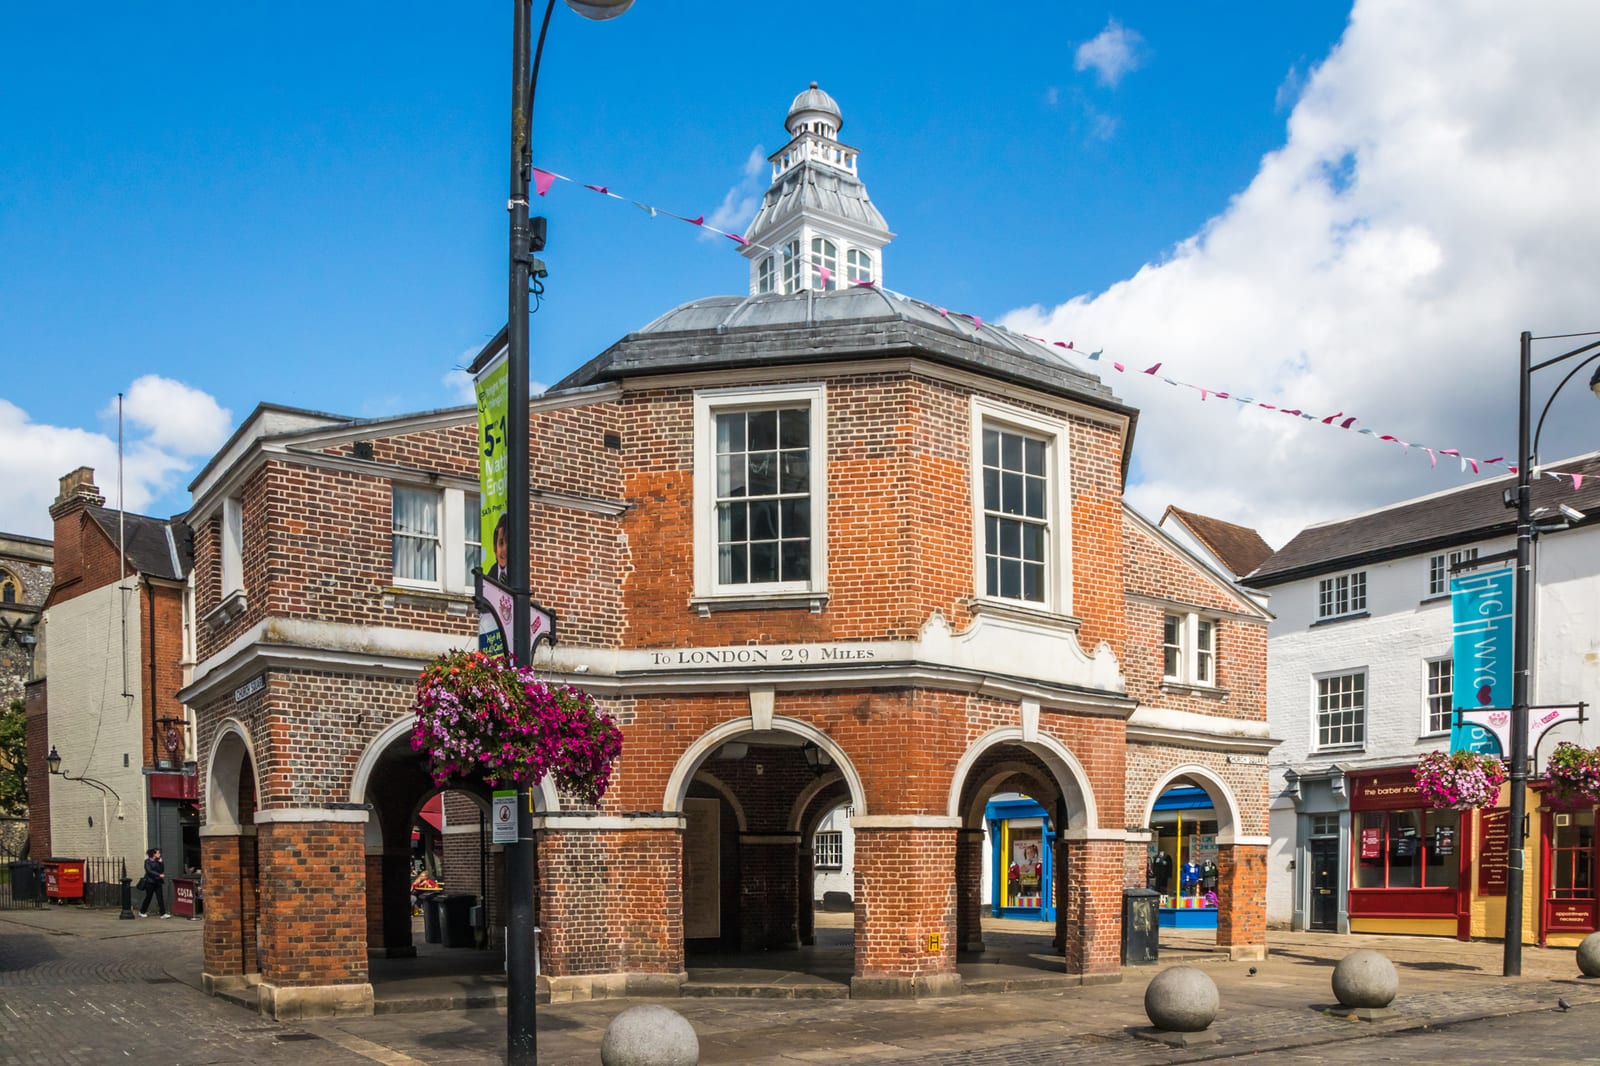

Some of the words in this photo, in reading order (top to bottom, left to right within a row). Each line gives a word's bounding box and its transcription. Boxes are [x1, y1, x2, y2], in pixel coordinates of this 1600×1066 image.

[650, 652, 671, 665] To
[678, 649, 769, 664] LONDON
[781, 648, 809, 663] 29
[1377, 787, 1401, 795] barber
[177, 887, 193, 897] COSTA
